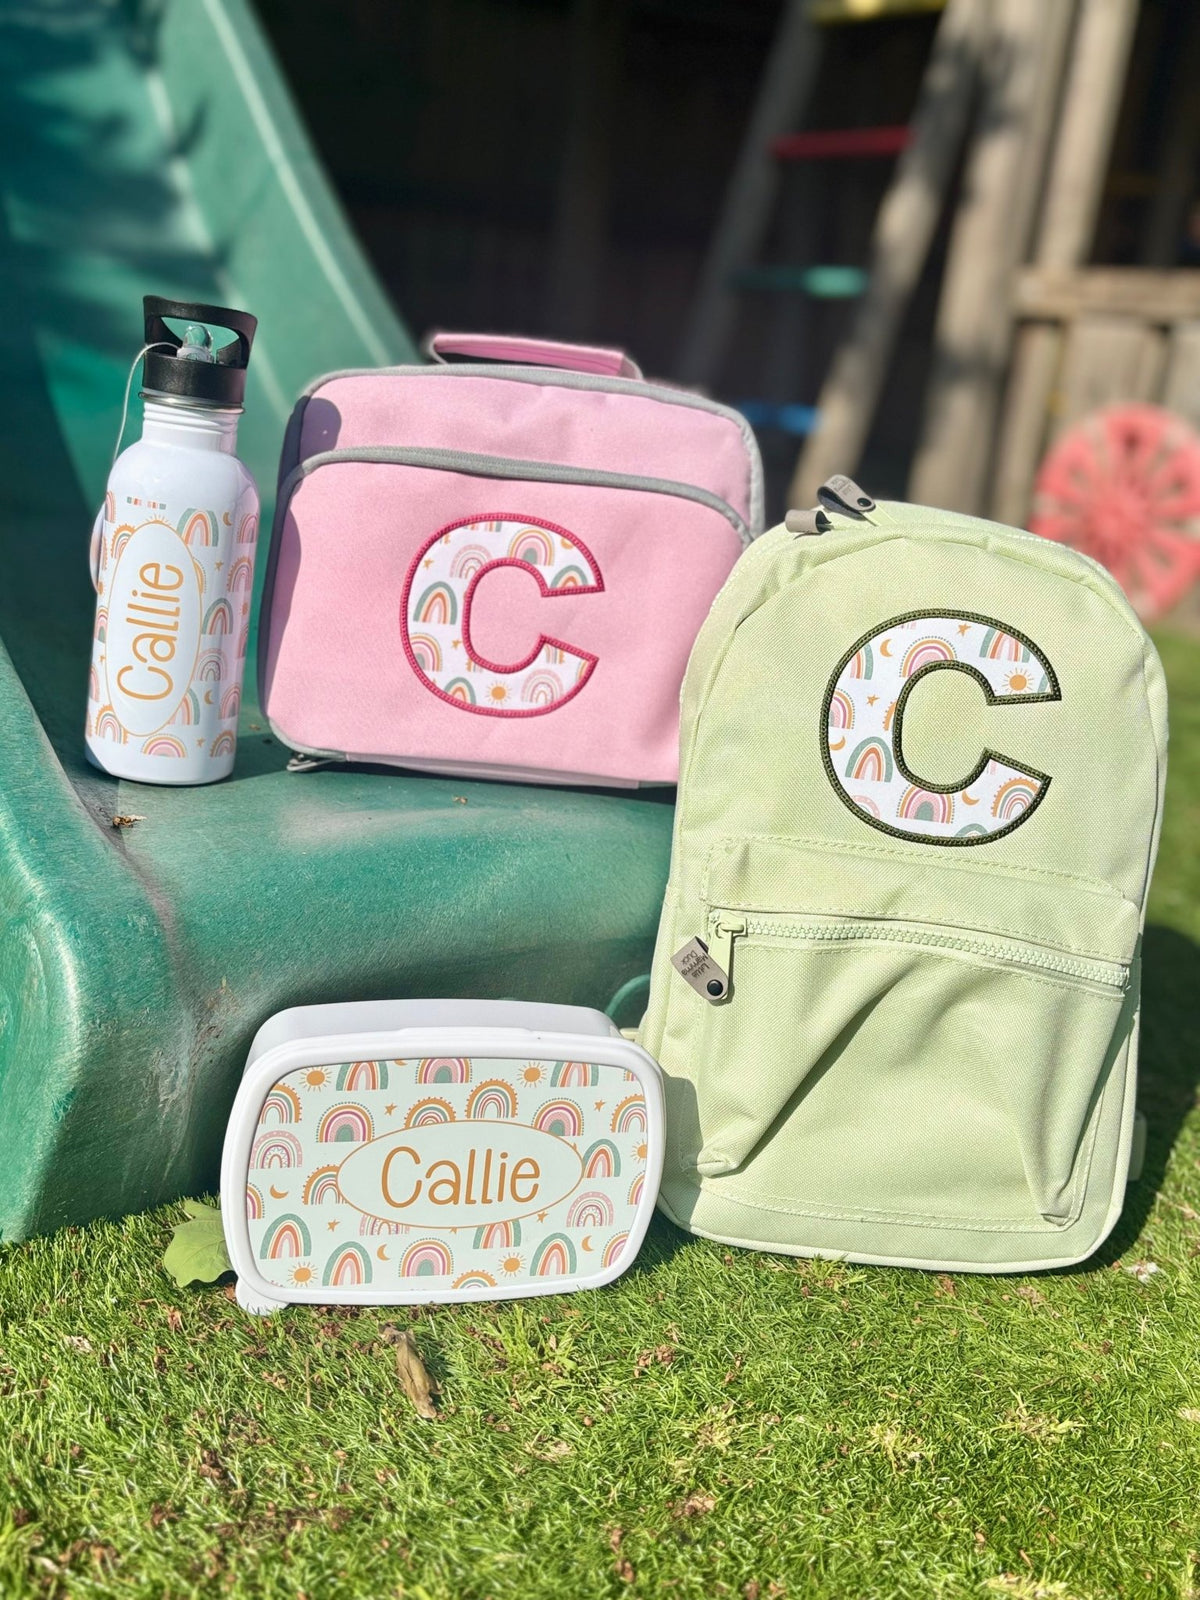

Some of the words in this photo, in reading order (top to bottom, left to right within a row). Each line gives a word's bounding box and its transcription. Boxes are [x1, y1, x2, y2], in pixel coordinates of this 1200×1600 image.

[117, 562, 184, 700] Callie
[681, 949, 698, 965] Duck
[380, 1145, 541, 1209] Callie
